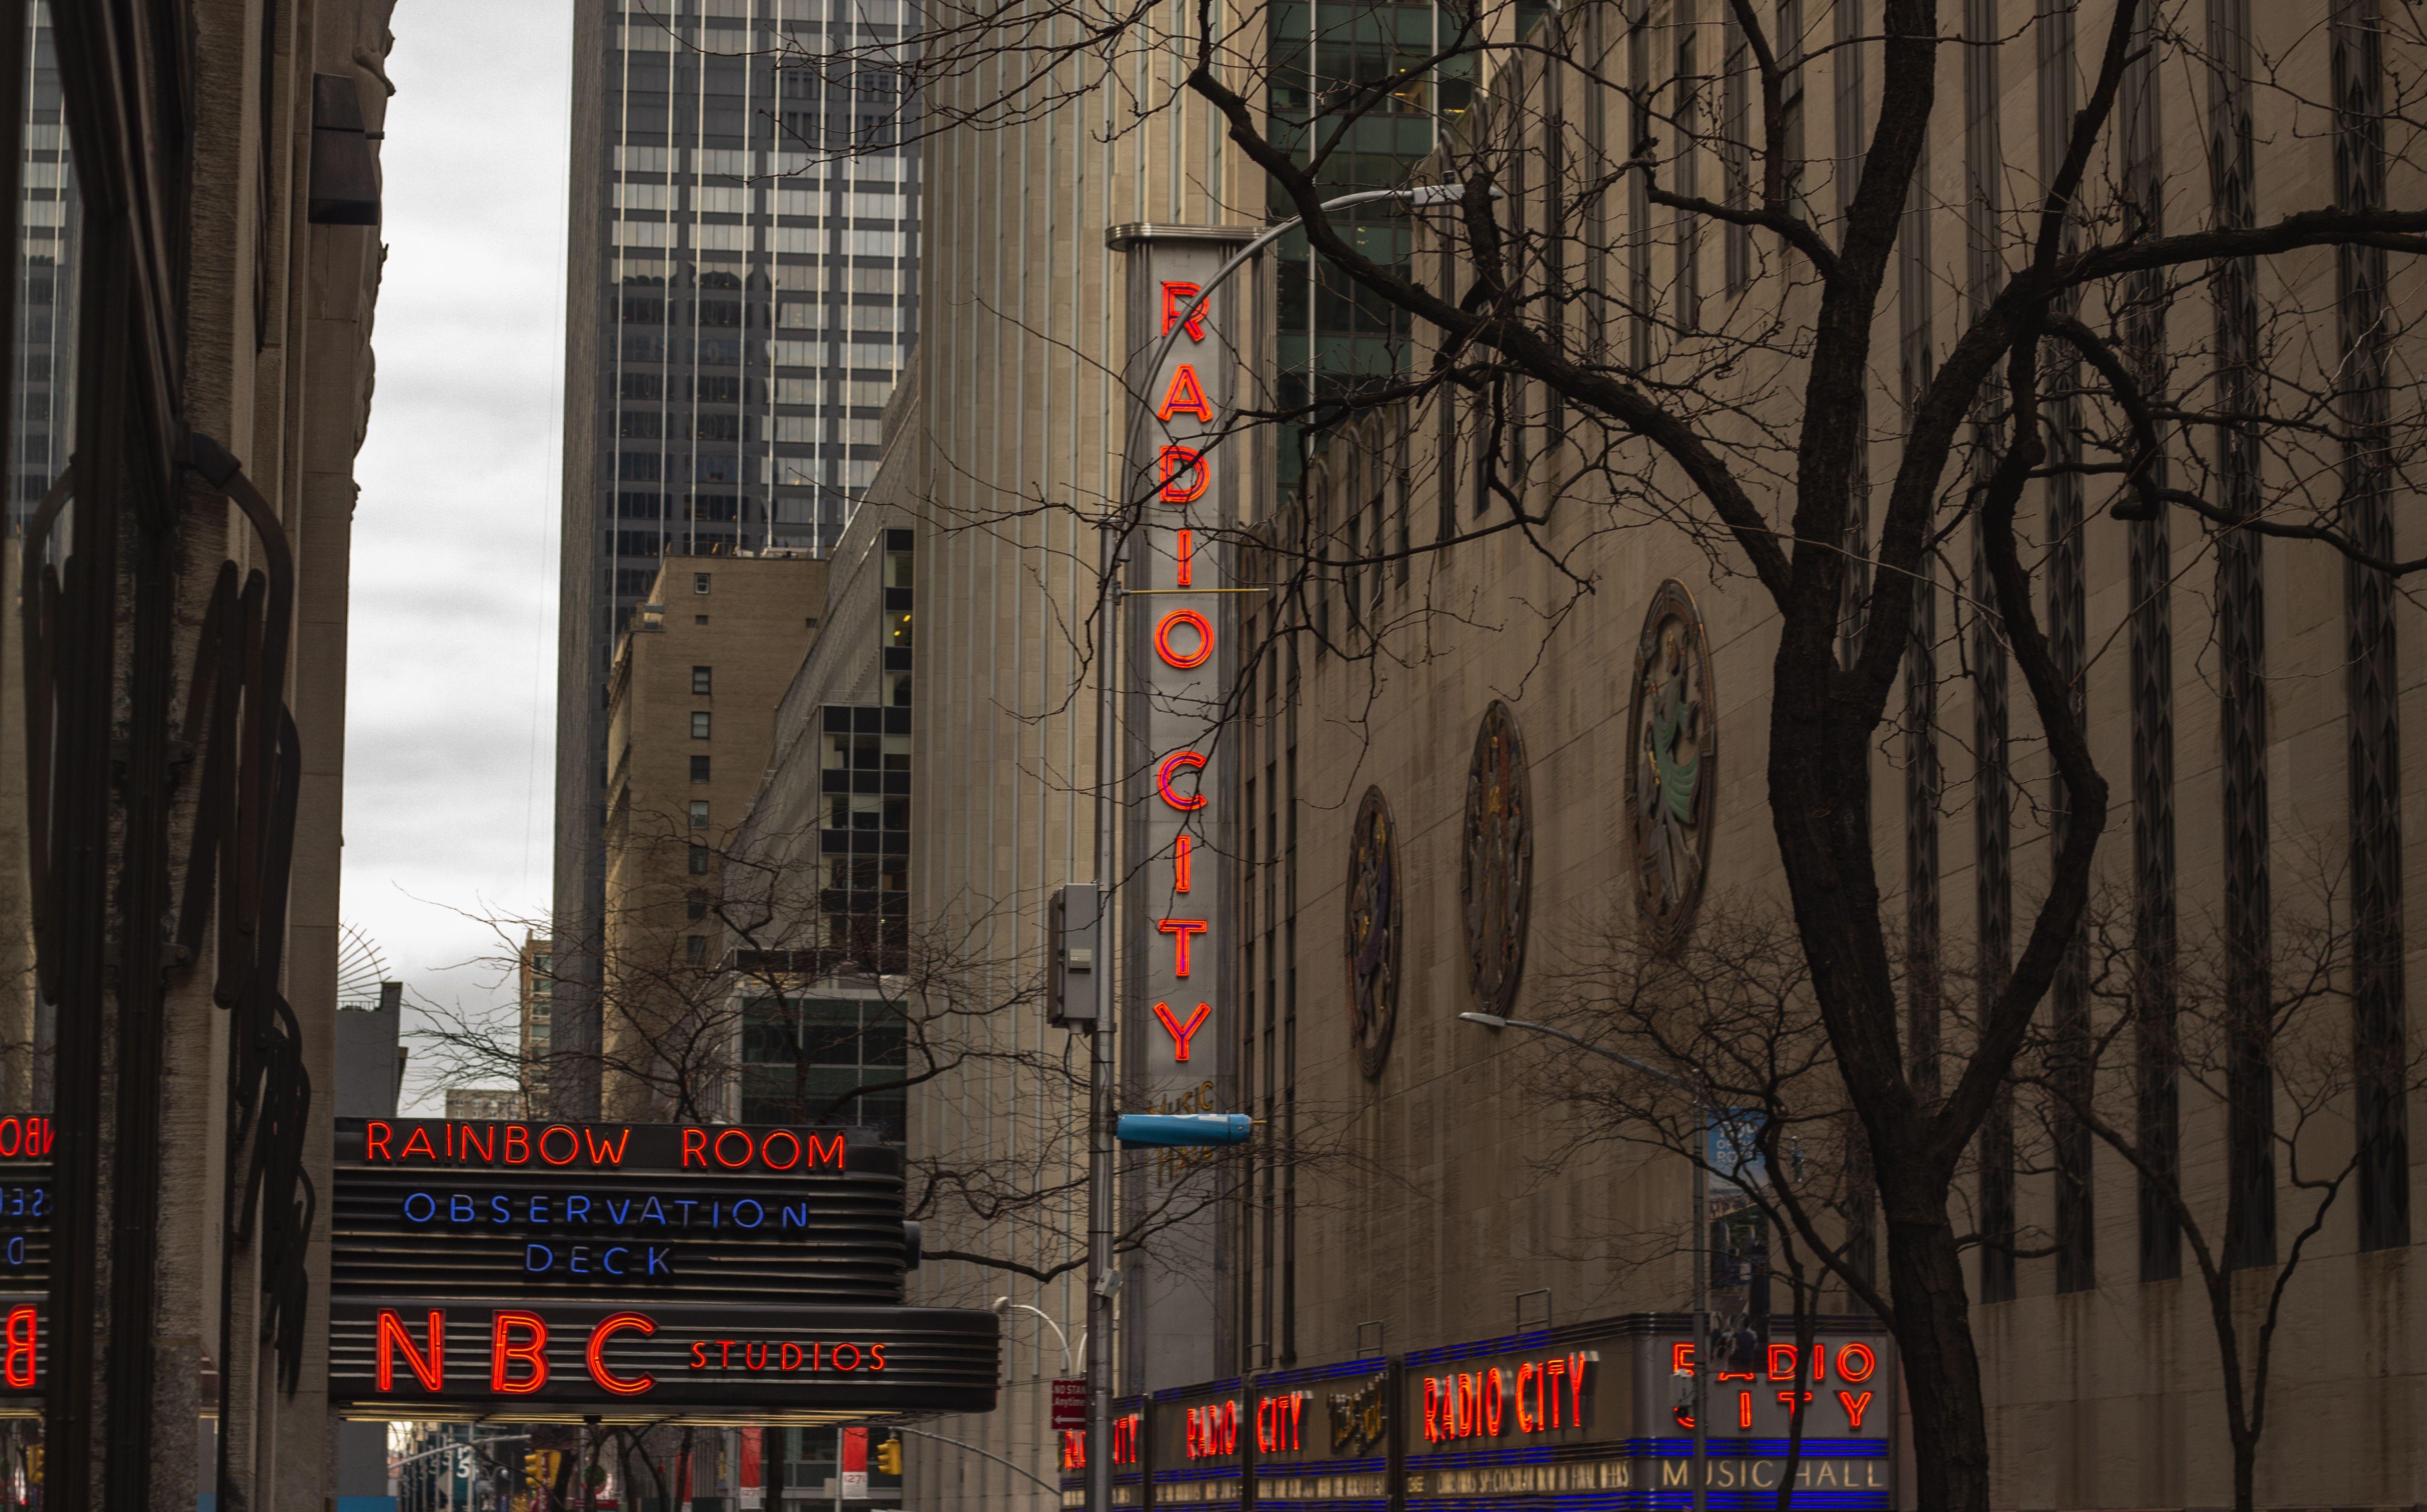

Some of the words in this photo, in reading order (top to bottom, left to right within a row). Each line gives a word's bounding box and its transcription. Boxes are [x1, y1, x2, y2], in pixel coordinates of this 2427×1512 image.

[1154, 280, 1215, 668] RADIO
[1153, 751, 1212, 1061] CITY
[367, 1121, 630, 1165] RAINBOW
[682, 1128, 846, 1170] ROOM
[404, 1192, 807, 1228] OBSERVATION
[526, 1244, 670, 1275] DECK
[375, 1308, 659, 1395] NBC
[691, 1340, 886, 1371] STUDIOS
[1672, 1342, 1876, 1383] RDIO
[1186, 1400, 1237, 1460] RADIO
[1256, 1392, 1303, 1453] CITY
[1424, 1366, 1503, 1443] RADIO
[1515, 1351, 1587, 1433] CITY
[1114, 1414, 1139, 1464] ITY
